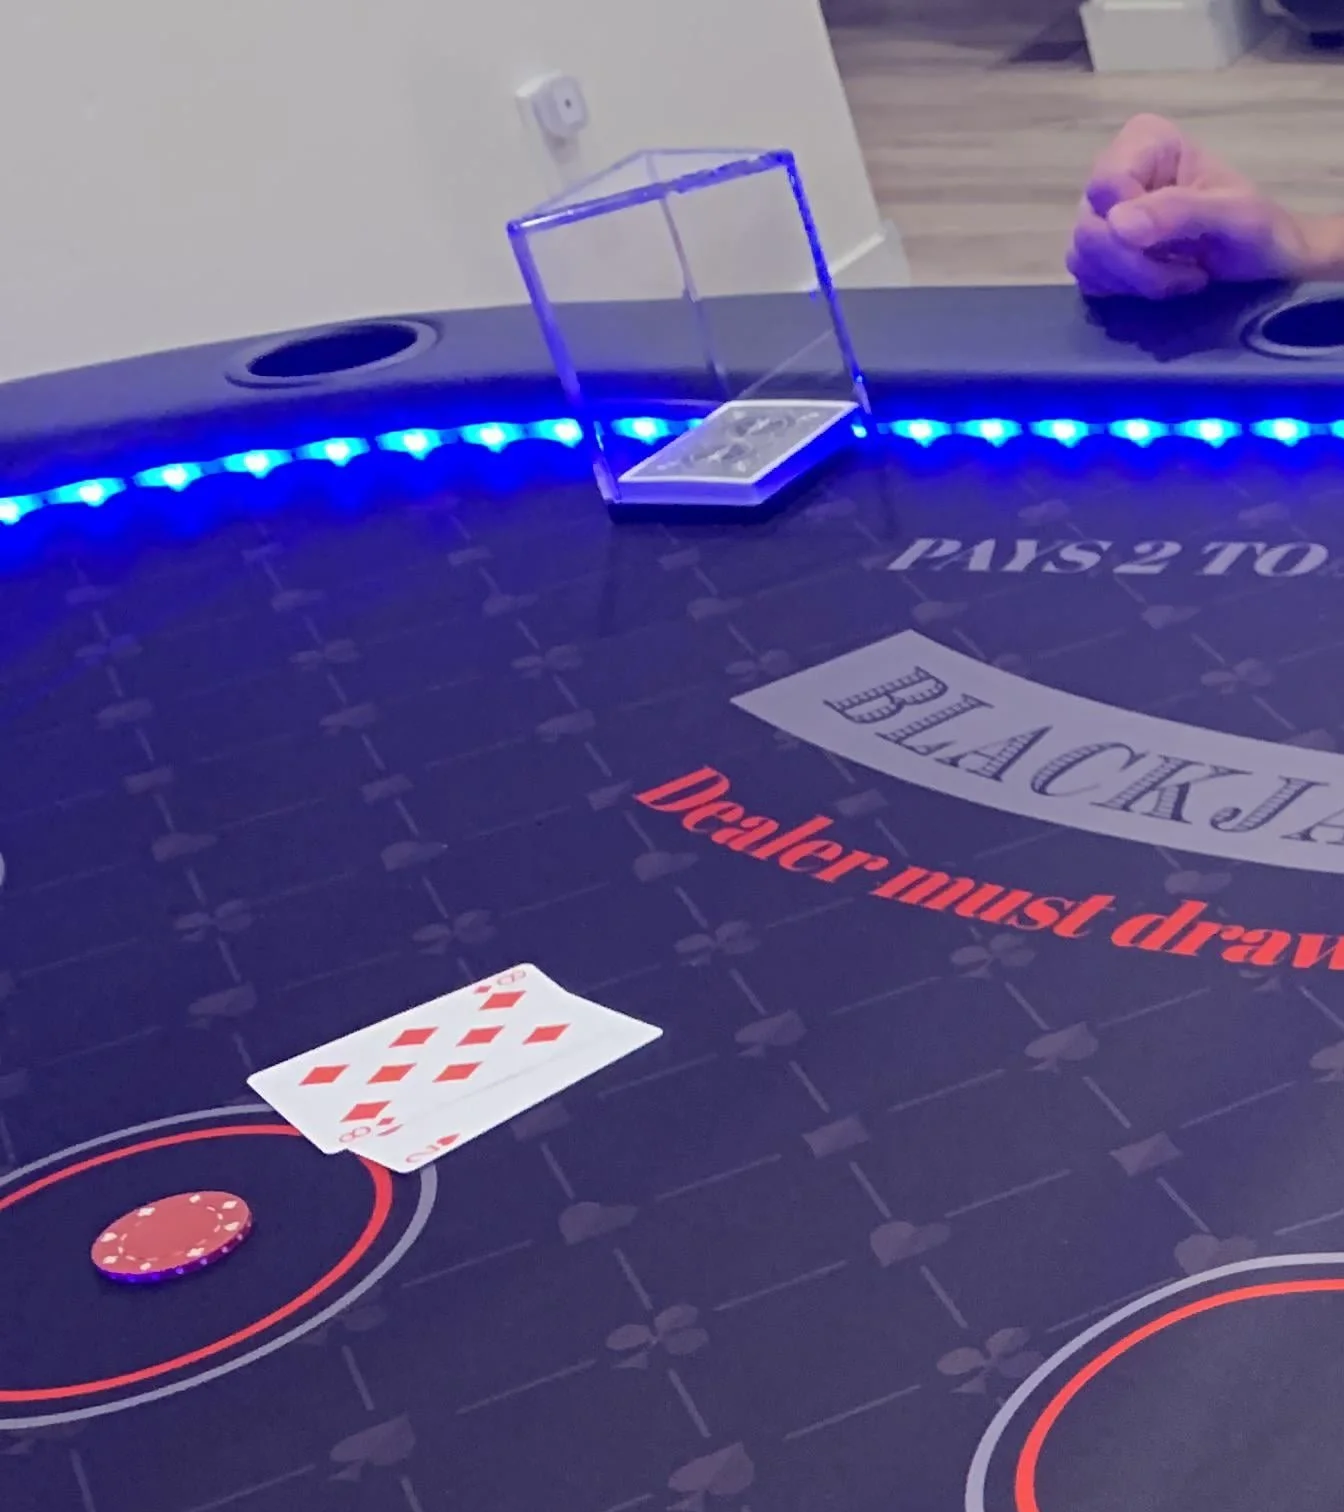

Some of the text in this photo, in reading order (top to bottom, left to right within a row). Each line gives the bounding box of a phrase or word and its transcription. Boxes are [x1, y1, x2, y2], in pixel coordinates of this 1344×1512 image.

[887, 537, 1112, 573] PAYS
[1112, 540, 1183, 574] 2
[1202, 542, 1328, 577] TO
[633, 766, 888, 883] Dealer
[868, 865, 1115, 939] must
